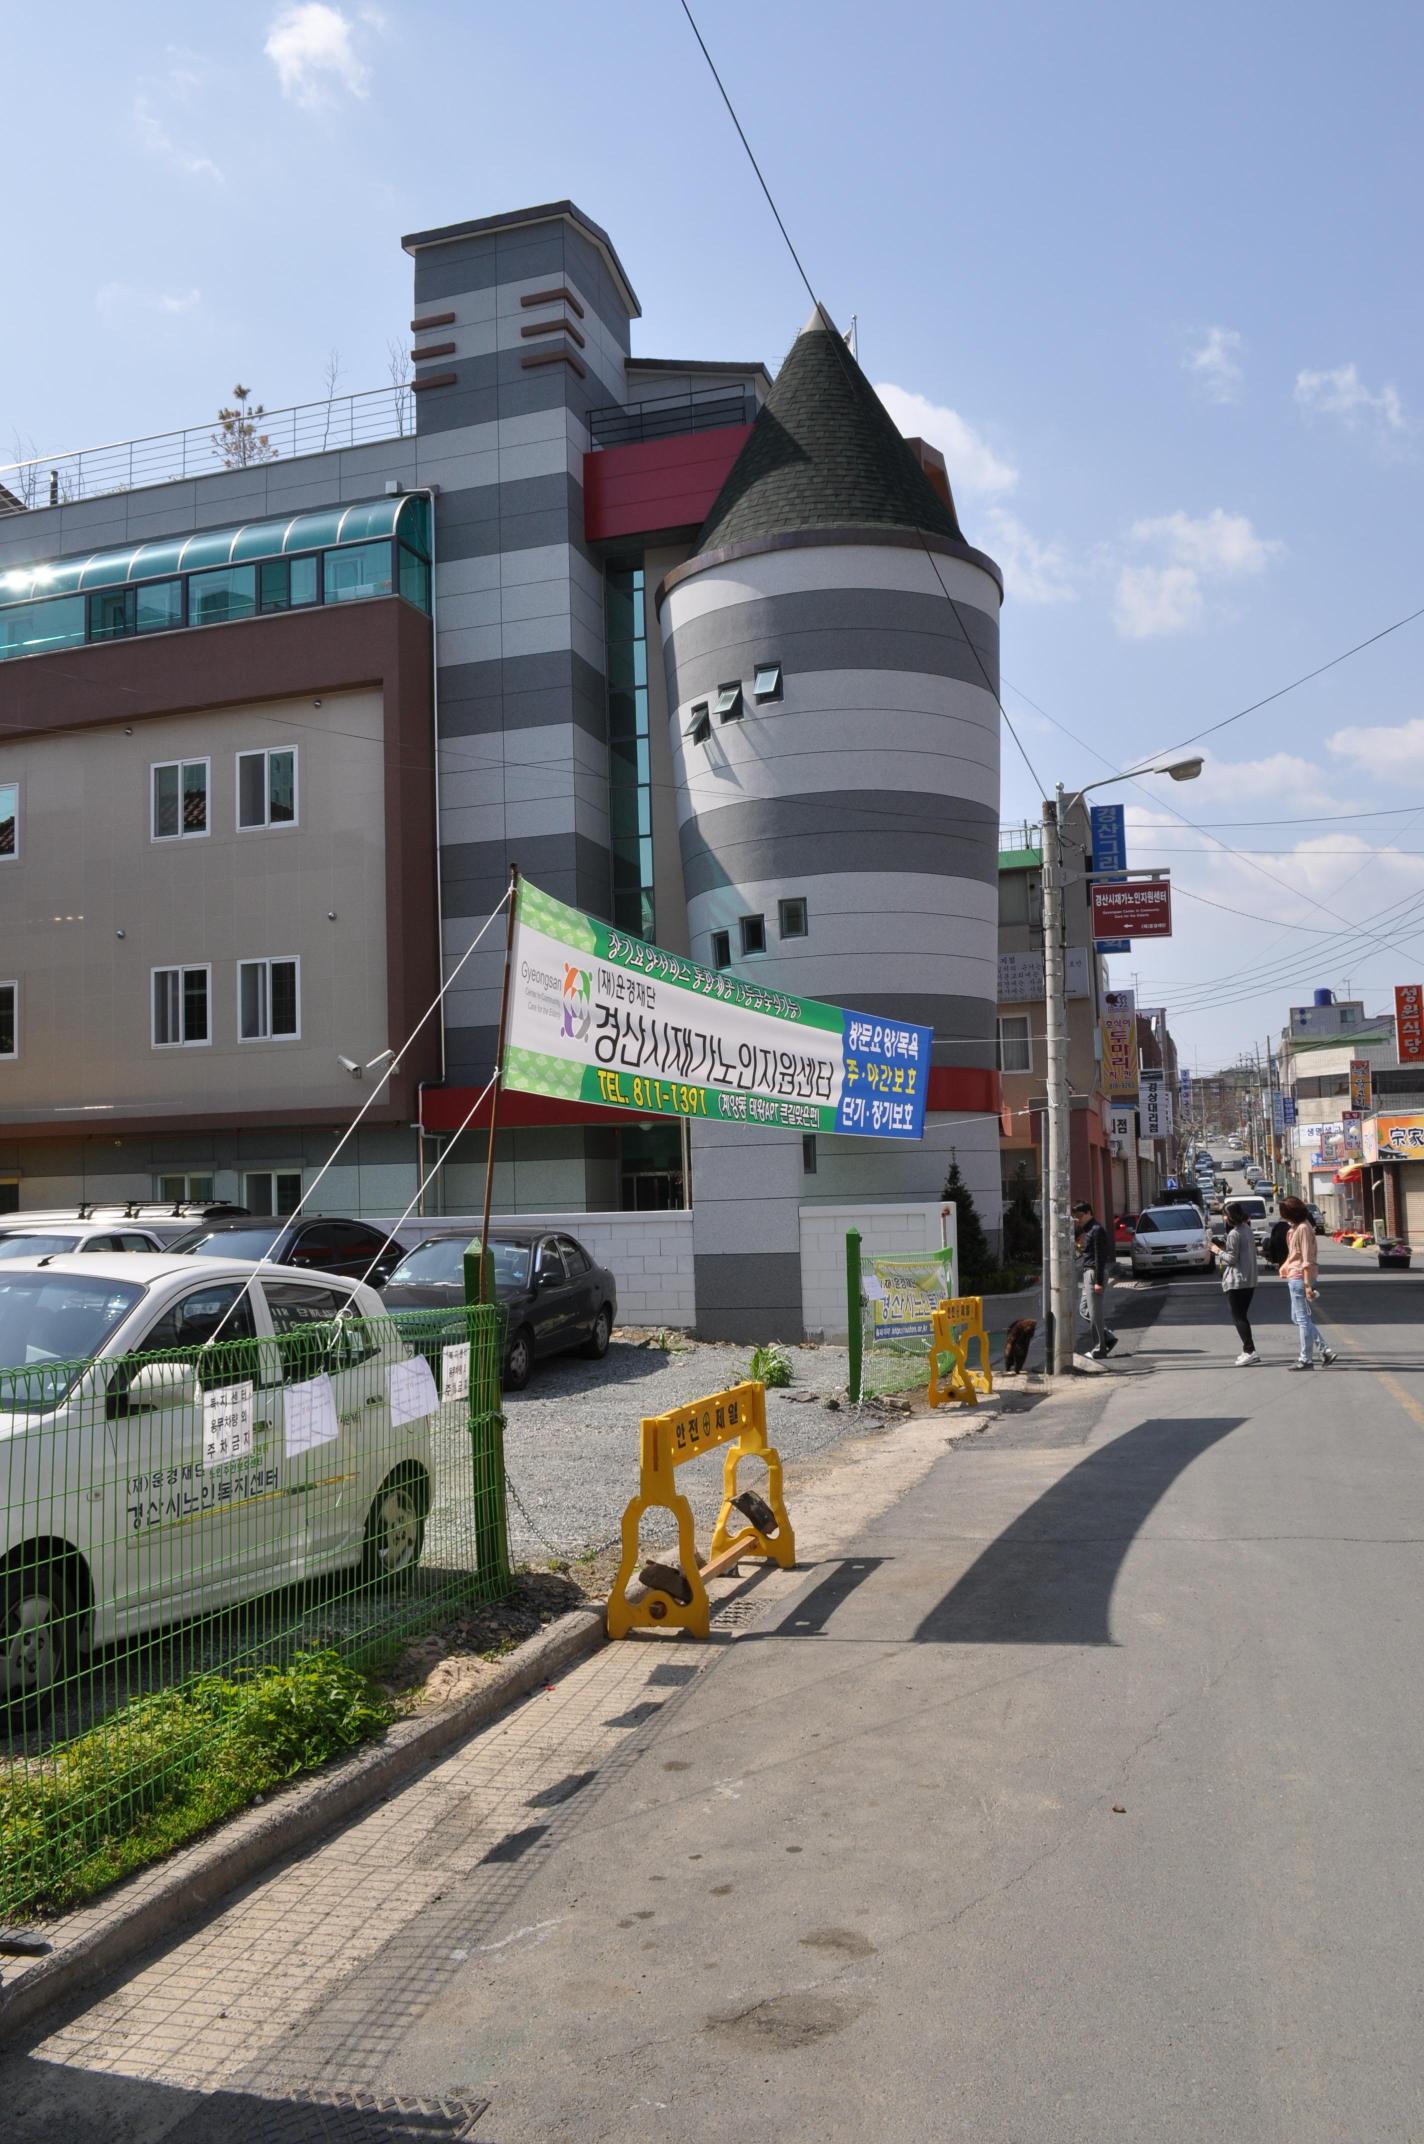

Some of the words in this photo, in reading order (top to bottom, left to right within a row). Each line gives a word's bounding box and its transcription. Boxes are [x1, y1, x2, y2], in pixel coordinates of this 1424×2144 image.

[1095, 890, 1167, 907] 경산시재가노인지원센터
[521, 961, 562, 992] Gyeongsan
[608, 931, 690, 982] 장기요양서비스
[597, 967, 656, 1010] (재)운경재단
[849, 1020, 919, 1061] 방문요양/목욕
[1401, 987, 1423, 1054] 성원식당
[595, 1003, 834, 1101] 경산시재가노인지원센터
[1110, 1030, 1130, 1070] 두마리
[597, 1068, 630, 1104] TEL.
[633, 1077, 707, 1116] 811-1391
[207, 1431, 252, 1460] 주차금지
[675, 1422, 700, 1449] 안전
[715, 1401, 739, 1430] 제일
[127, 1466, 279, 1530] 경산시노인복지센터
